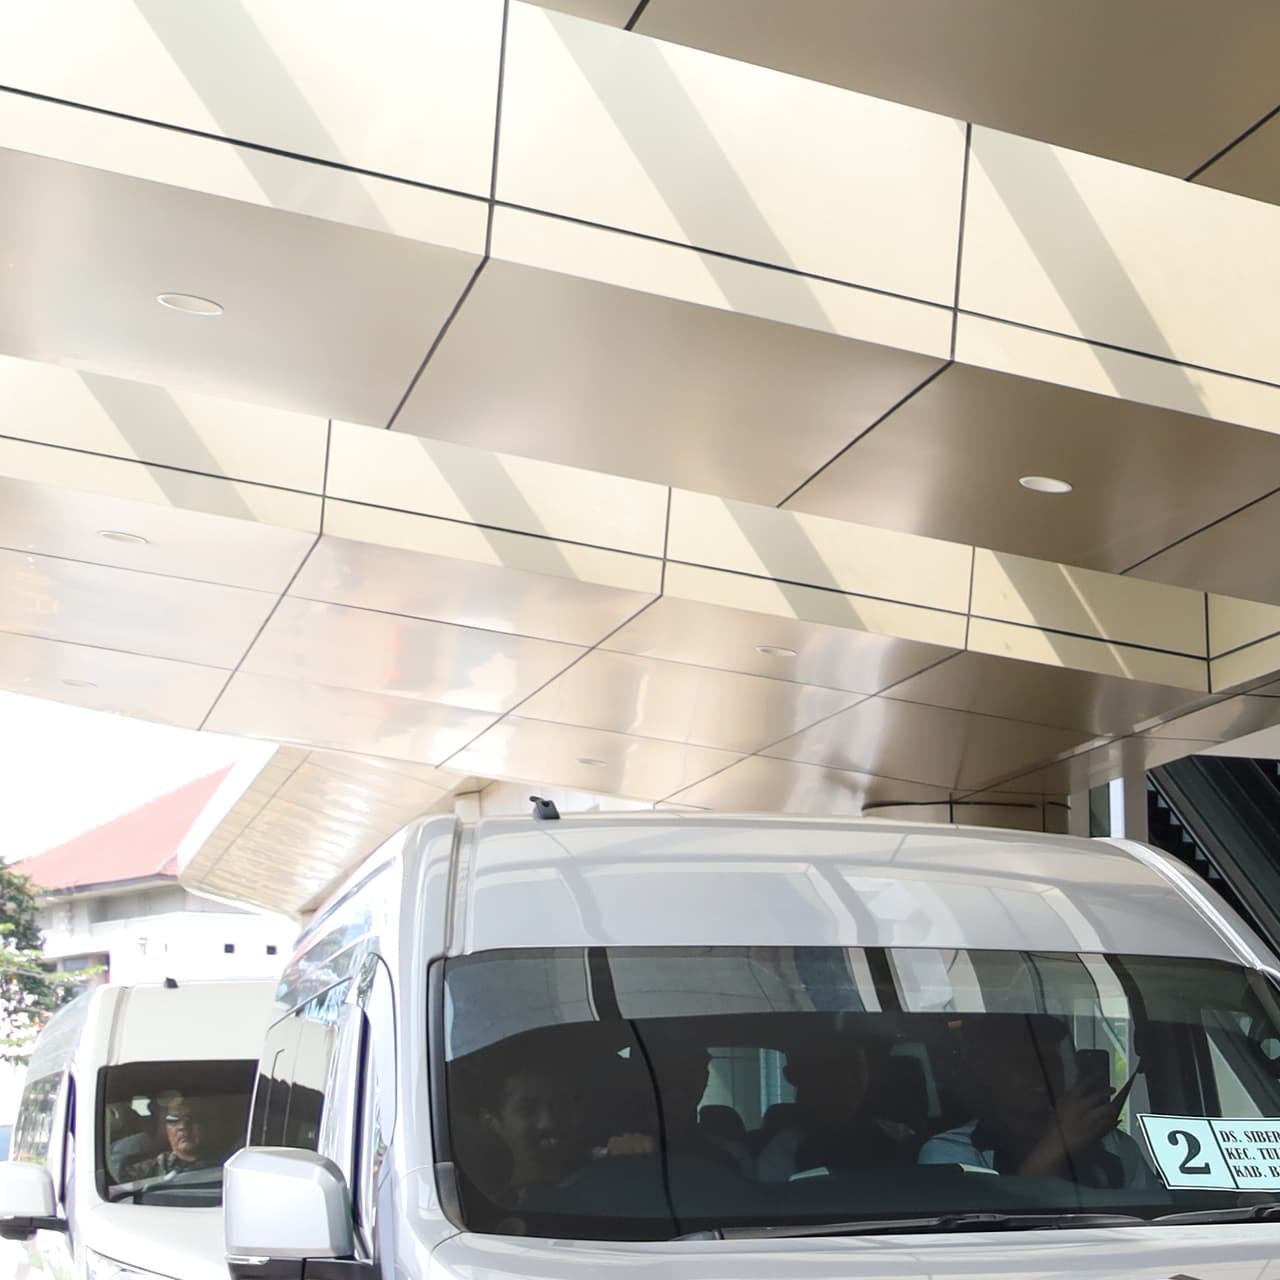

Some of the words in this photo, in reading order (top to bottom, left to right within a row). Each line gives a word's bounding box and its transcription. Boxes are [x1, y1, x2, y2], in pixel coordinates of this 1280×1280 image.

[1219, 1130, 1242, 1143] DS.
[1167, 1130, 1211, 1175] 2
[1225, 1147, 1256, 1160] KEC.
[1233, 1165, 1267, 1178] KAB.
